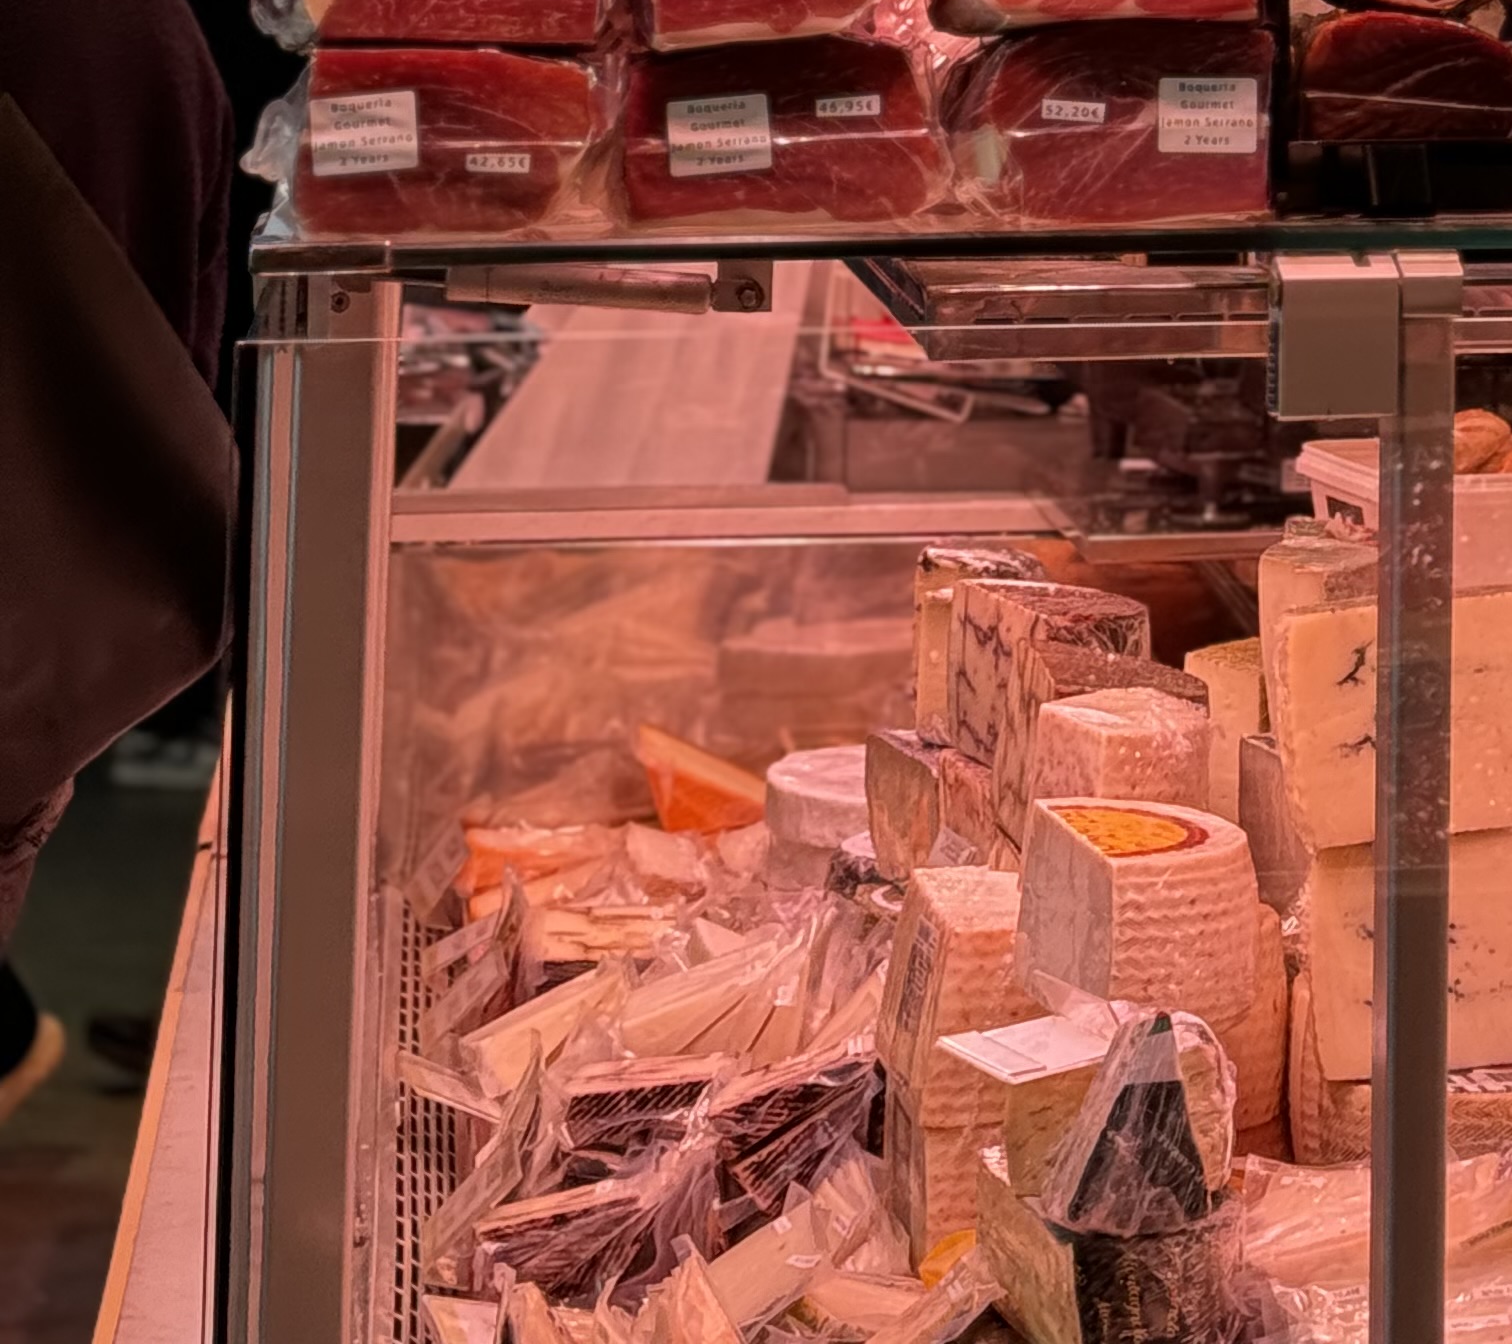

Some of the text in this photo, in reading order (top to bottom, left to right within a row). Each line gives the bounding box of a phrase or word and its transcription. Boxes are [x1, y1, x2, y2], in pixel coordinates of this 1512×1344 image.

[1180, 100, 1234, 110] Gourmet
[334, 117, 391, 130] Gourmet
[690, 119, 745, 131] Gourmet
